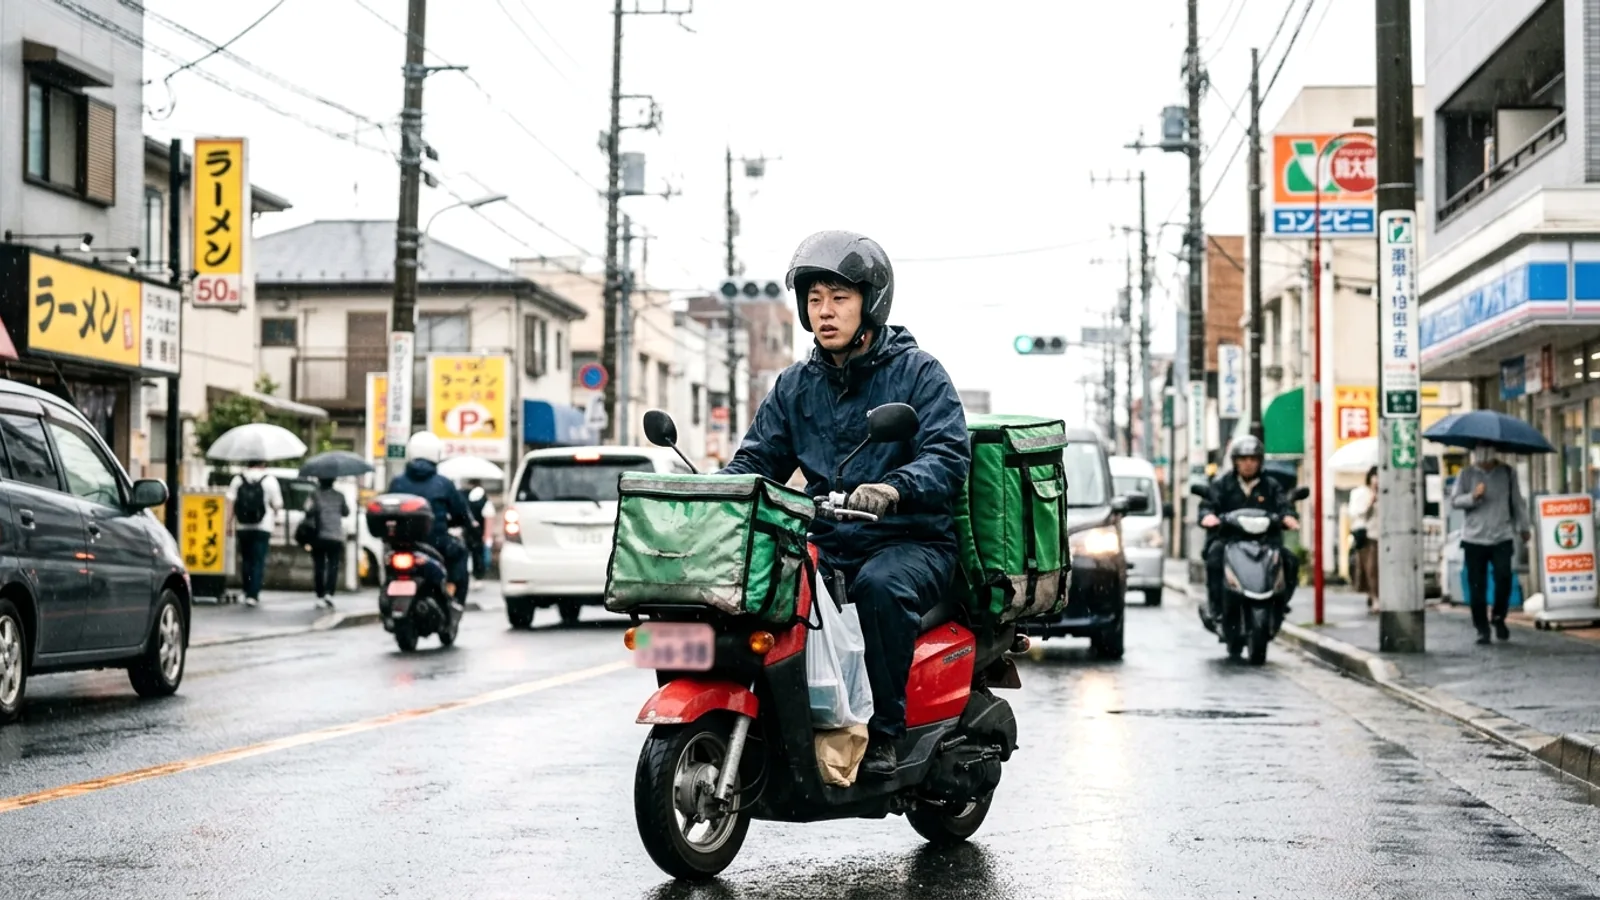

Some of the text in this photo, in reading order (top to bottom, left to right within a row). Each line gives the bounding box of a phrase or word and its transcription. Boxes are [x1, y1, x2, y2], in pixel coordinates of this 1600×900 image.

[205, 150, 231, 267] ラーメン
[36, 276, 118, 344] ラーメン
[459, 409, 479, 432] P
[202, 498, 218, 568] ラーメン
